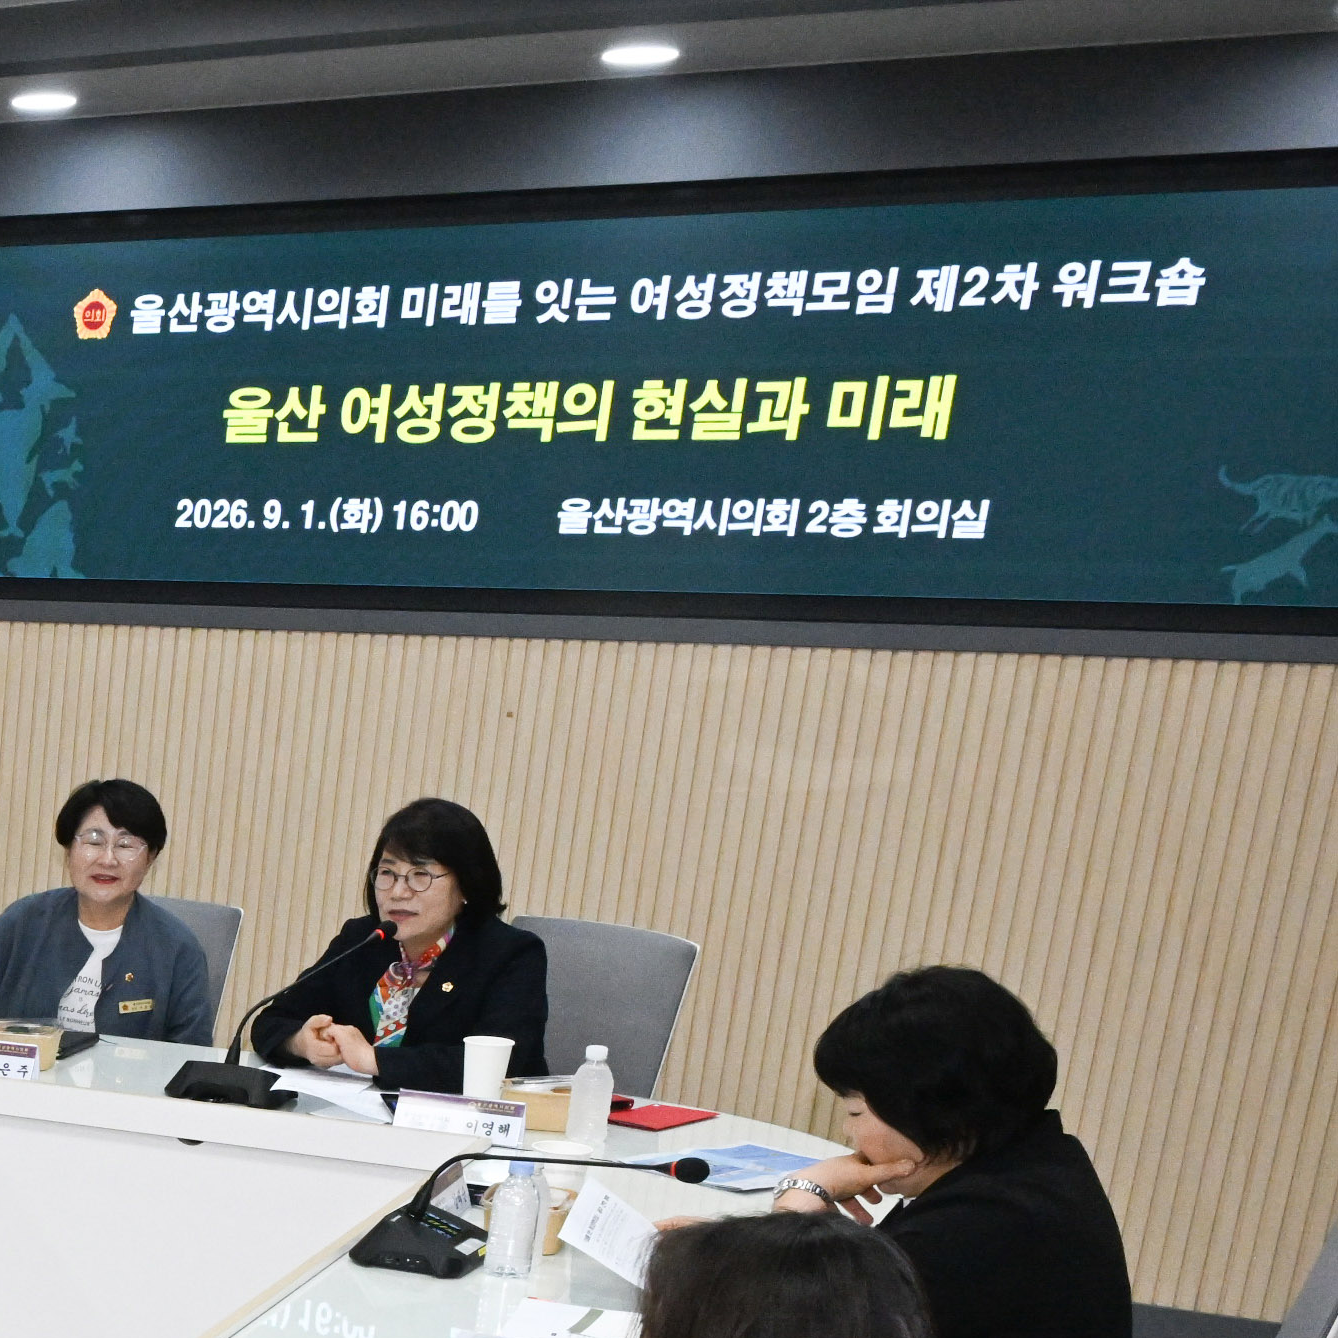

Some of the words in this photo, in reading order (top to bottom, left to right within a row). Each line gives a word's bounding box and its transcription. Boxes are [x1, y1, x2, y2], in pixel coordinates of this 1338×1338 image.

[130, 285, 390, 334] 울산광역시의회
[401, 281, 522, 326] 미래를
[536, 278, 616, 324] 잇는
[630, 267, 900, 320] 여성정책모임
[909, 262, 1039, 312] 제2차
[1053, 257, 1206, 308] 워크숍
[223, 385, 326, 443] 울산
[340, 380, 615, 443] 여성정책의
[631, 377, 809, 440] 현실과
[826, 374, 957, 440] 미래
[175, 498, 255, 529] 2026.
[262, 500, 289, 530] 9.
[393, 500, 479, 532] 16:00
[557, 497, 800, 537] 울산광역시의회
[806, 499, 867, 539] 2층
[872, 498, 990, 539] 회의실
